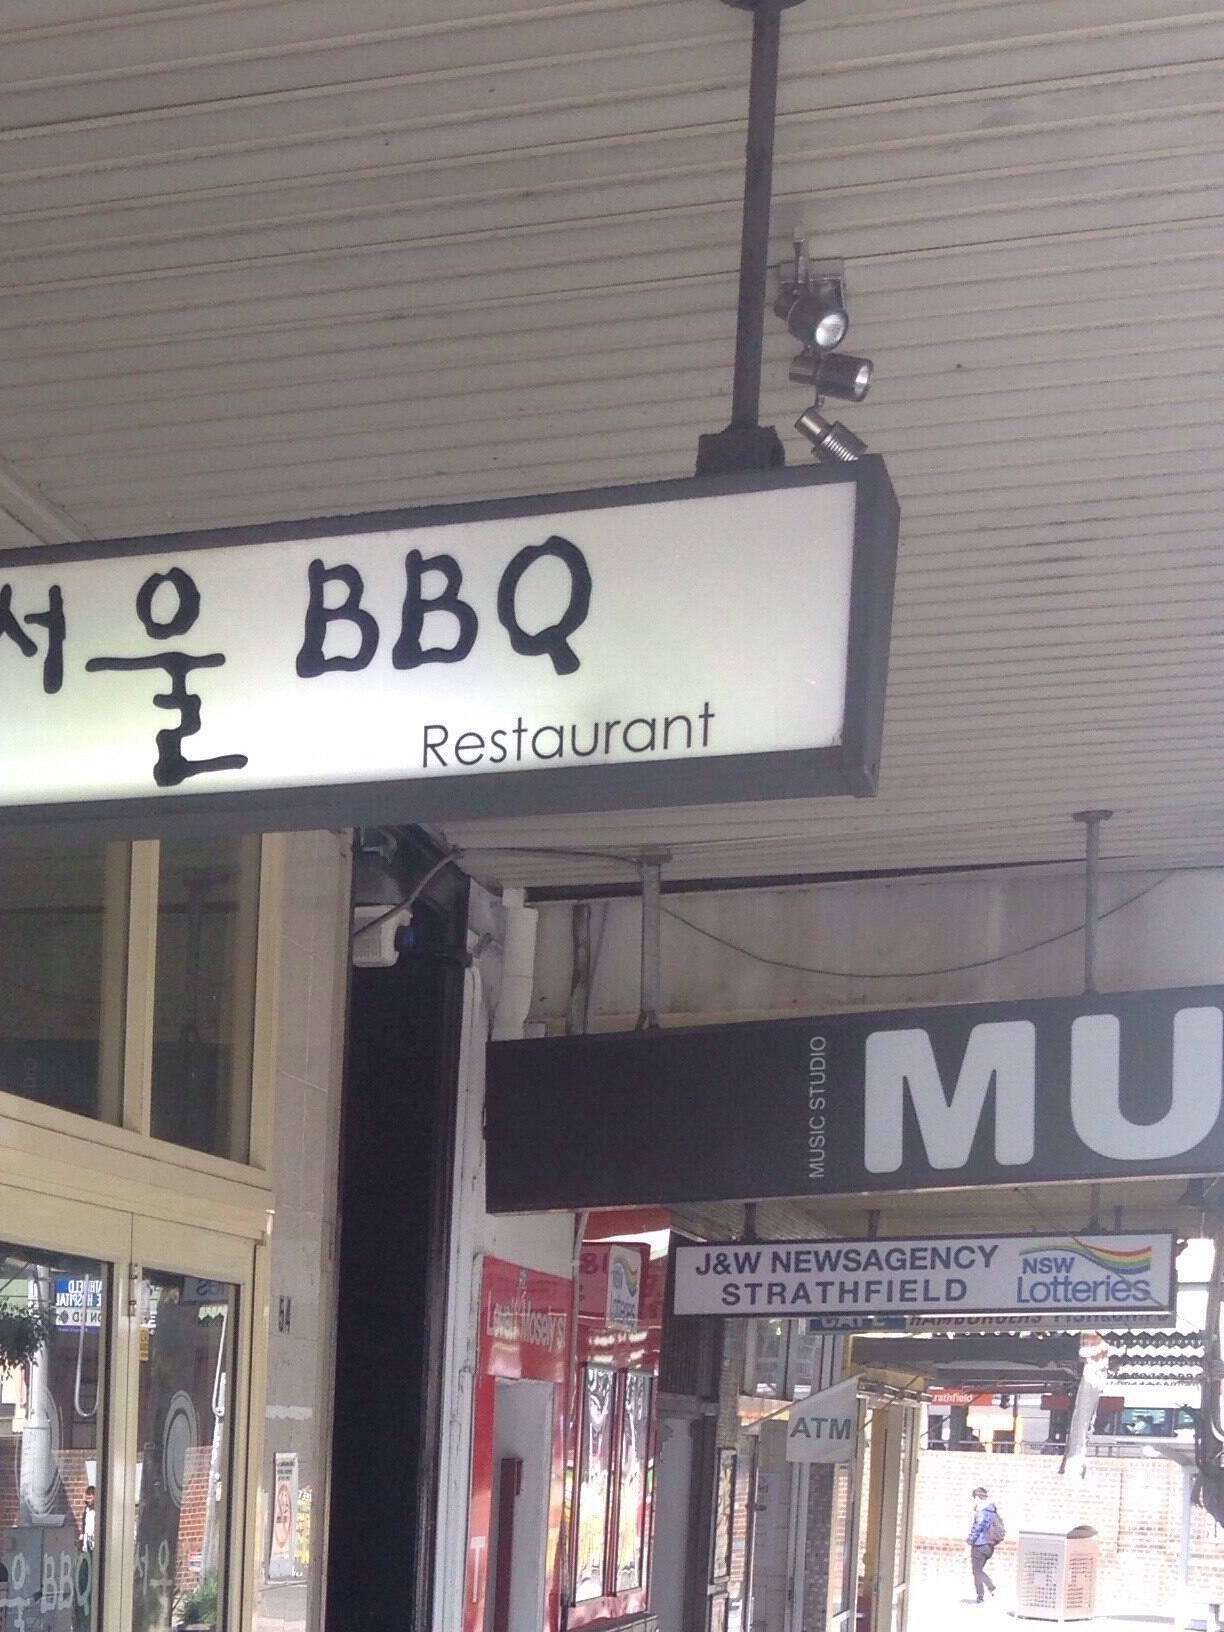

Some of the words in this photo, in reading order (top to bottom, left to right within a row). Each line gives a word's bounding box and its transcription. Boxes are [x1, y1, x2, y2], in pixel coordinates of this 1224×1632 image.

[296, 536, 592, 676] BBQ
[422, 702, 715, 768] Restaurant
[808, 1035, 827, 1112] STUDIO
[864, 1006, 1223, 1174] MU
[808, 1113, 826, 1178] MUSIC
[696, 1252, 761, 1276] J&W
[771, 1244, 999, 1274] NEWSAGENCY
[721, 1278, 967, 1306] STRATHFIELD
[1017, 1275, 1152, 1304] Lotteries
[1022, 1256, 1075, 1275] NSW
[789, 1416, 852, 1441] ATM
[40, 1550, 93, 1617] BBQ
